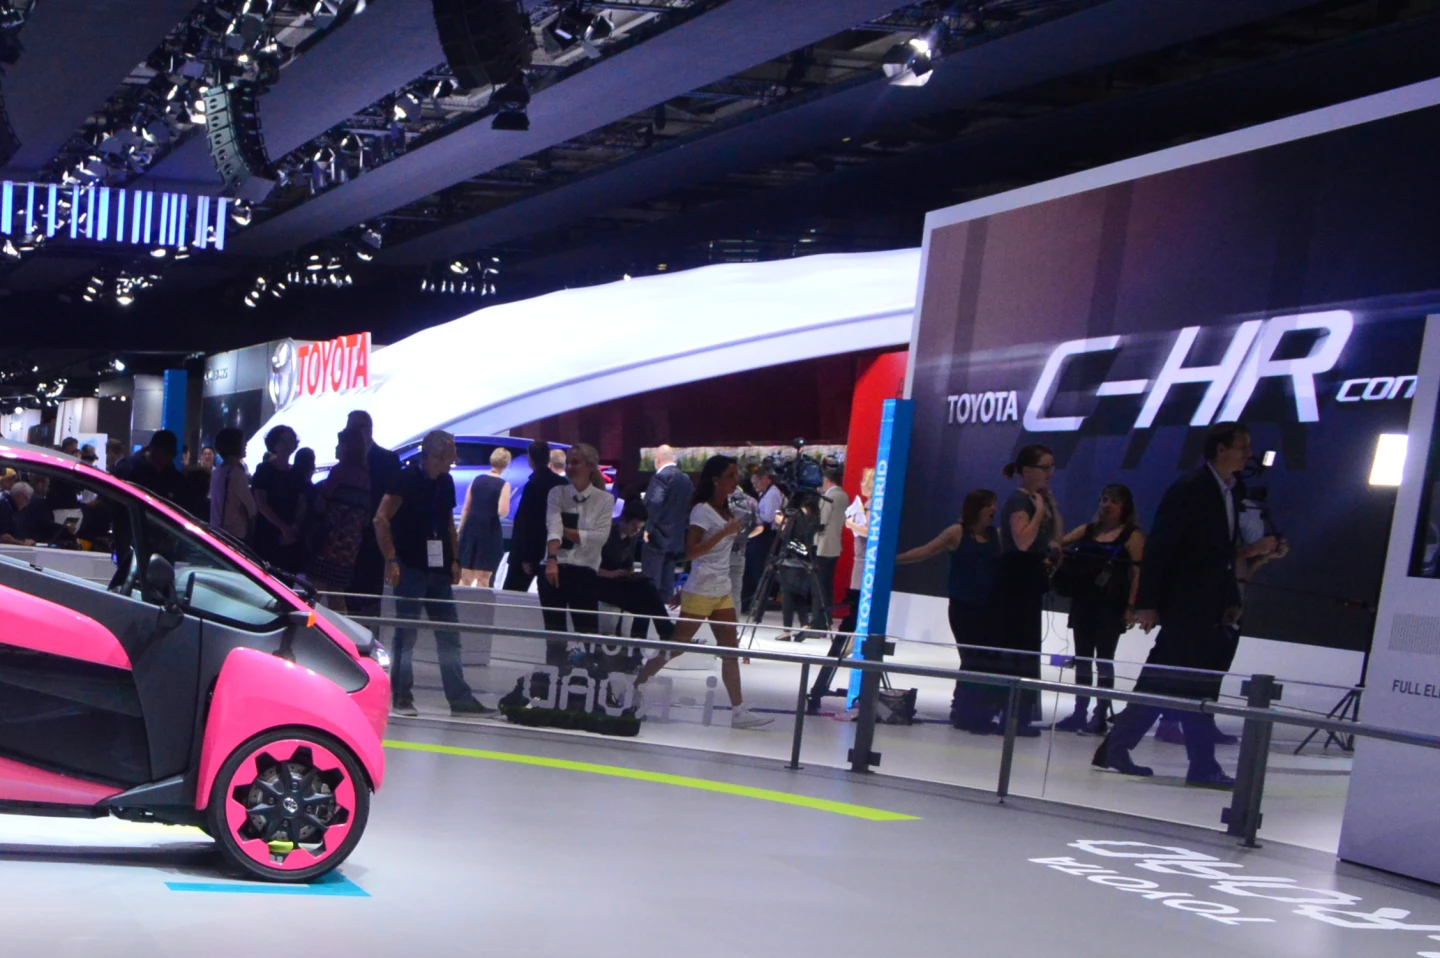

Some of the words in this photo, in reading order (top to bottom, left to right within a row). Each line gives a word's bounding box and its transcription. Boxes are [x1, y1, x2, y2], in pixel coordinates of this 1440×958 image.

[298, 331, 371, 396] TOYOTA
[947, 390, 1018, 424] TOYOTA
[1022, 309, 1354, 432] C-HR
[859, 545, 877, 628] TOYOTA
[868, 459, 888, 541] HYBRID
[1392, 680, 1423, 696] FULL
[1027, 856, 1277, 925] TOYOTA
